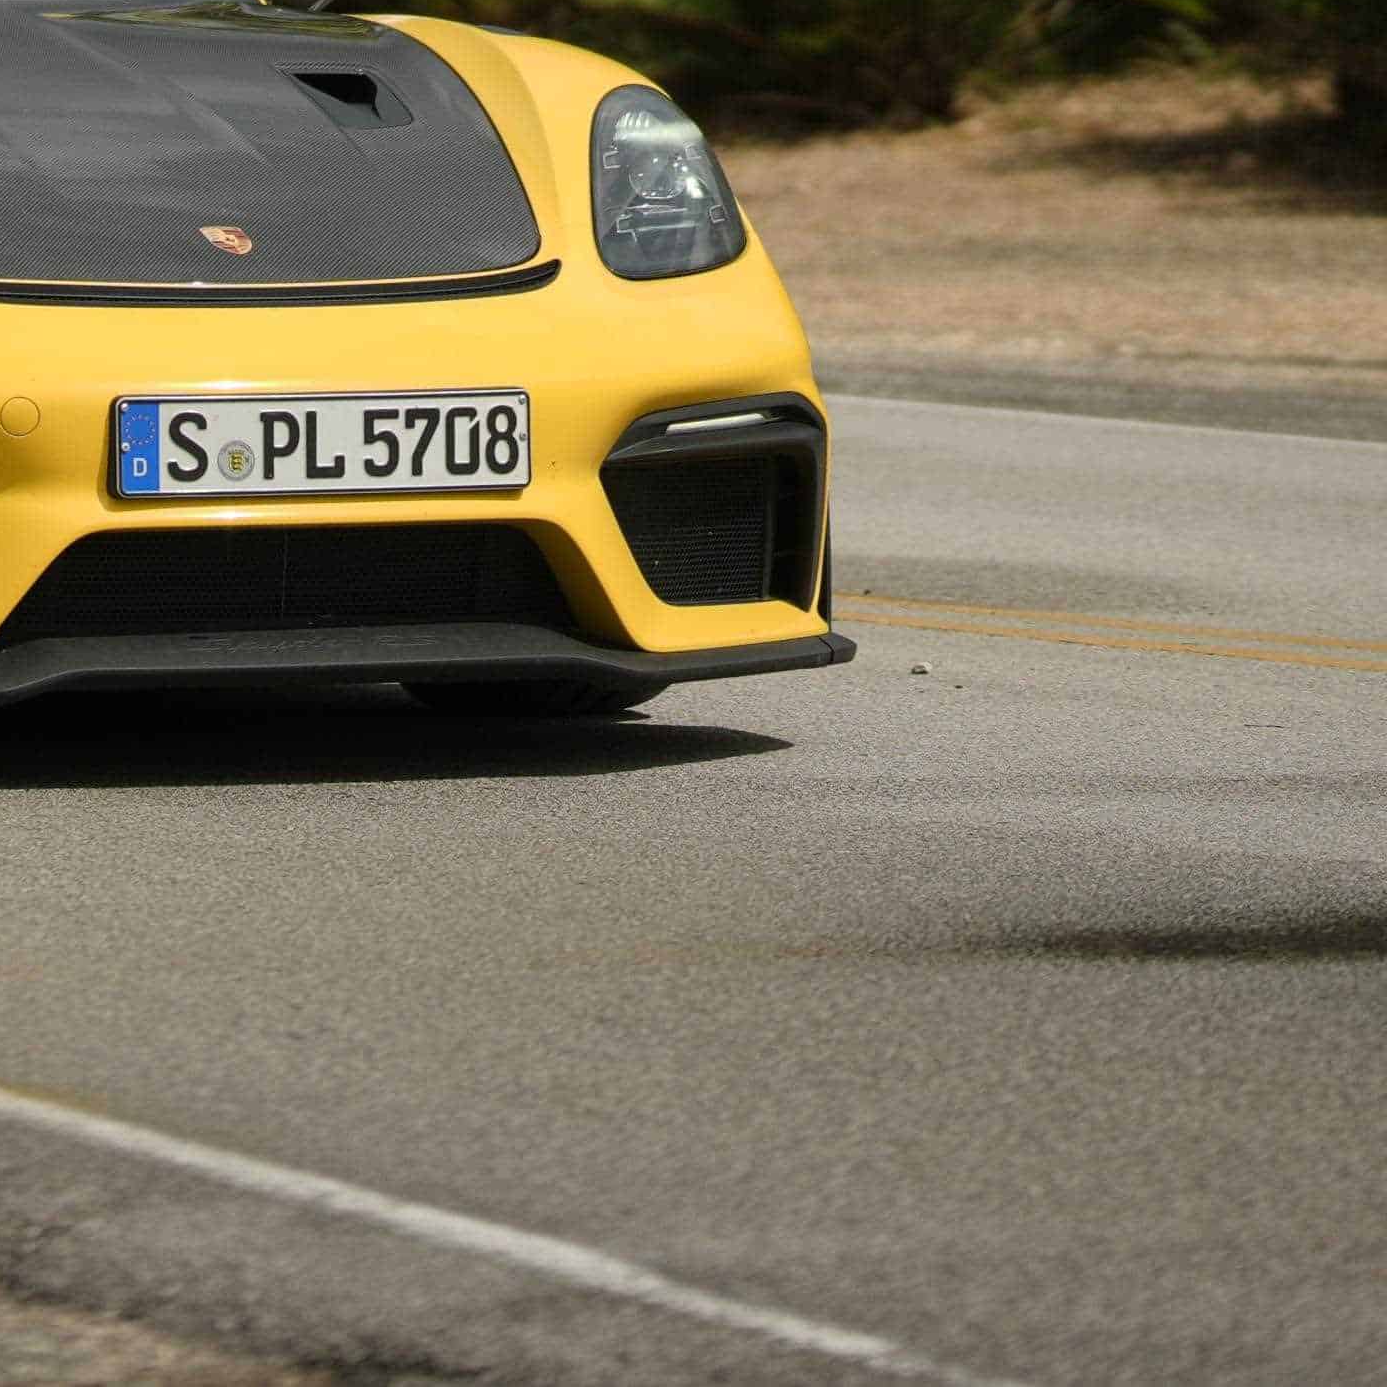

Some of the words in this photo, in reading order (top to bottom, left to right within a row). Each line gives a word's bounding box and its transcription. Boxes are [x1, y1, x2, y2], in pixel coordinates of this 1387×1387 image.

[132, 457, 148, 477] D
[167, 411, 209, 482] S
[259, 410, 346, 480] PL
[363, 404, 520, 478] 5708
